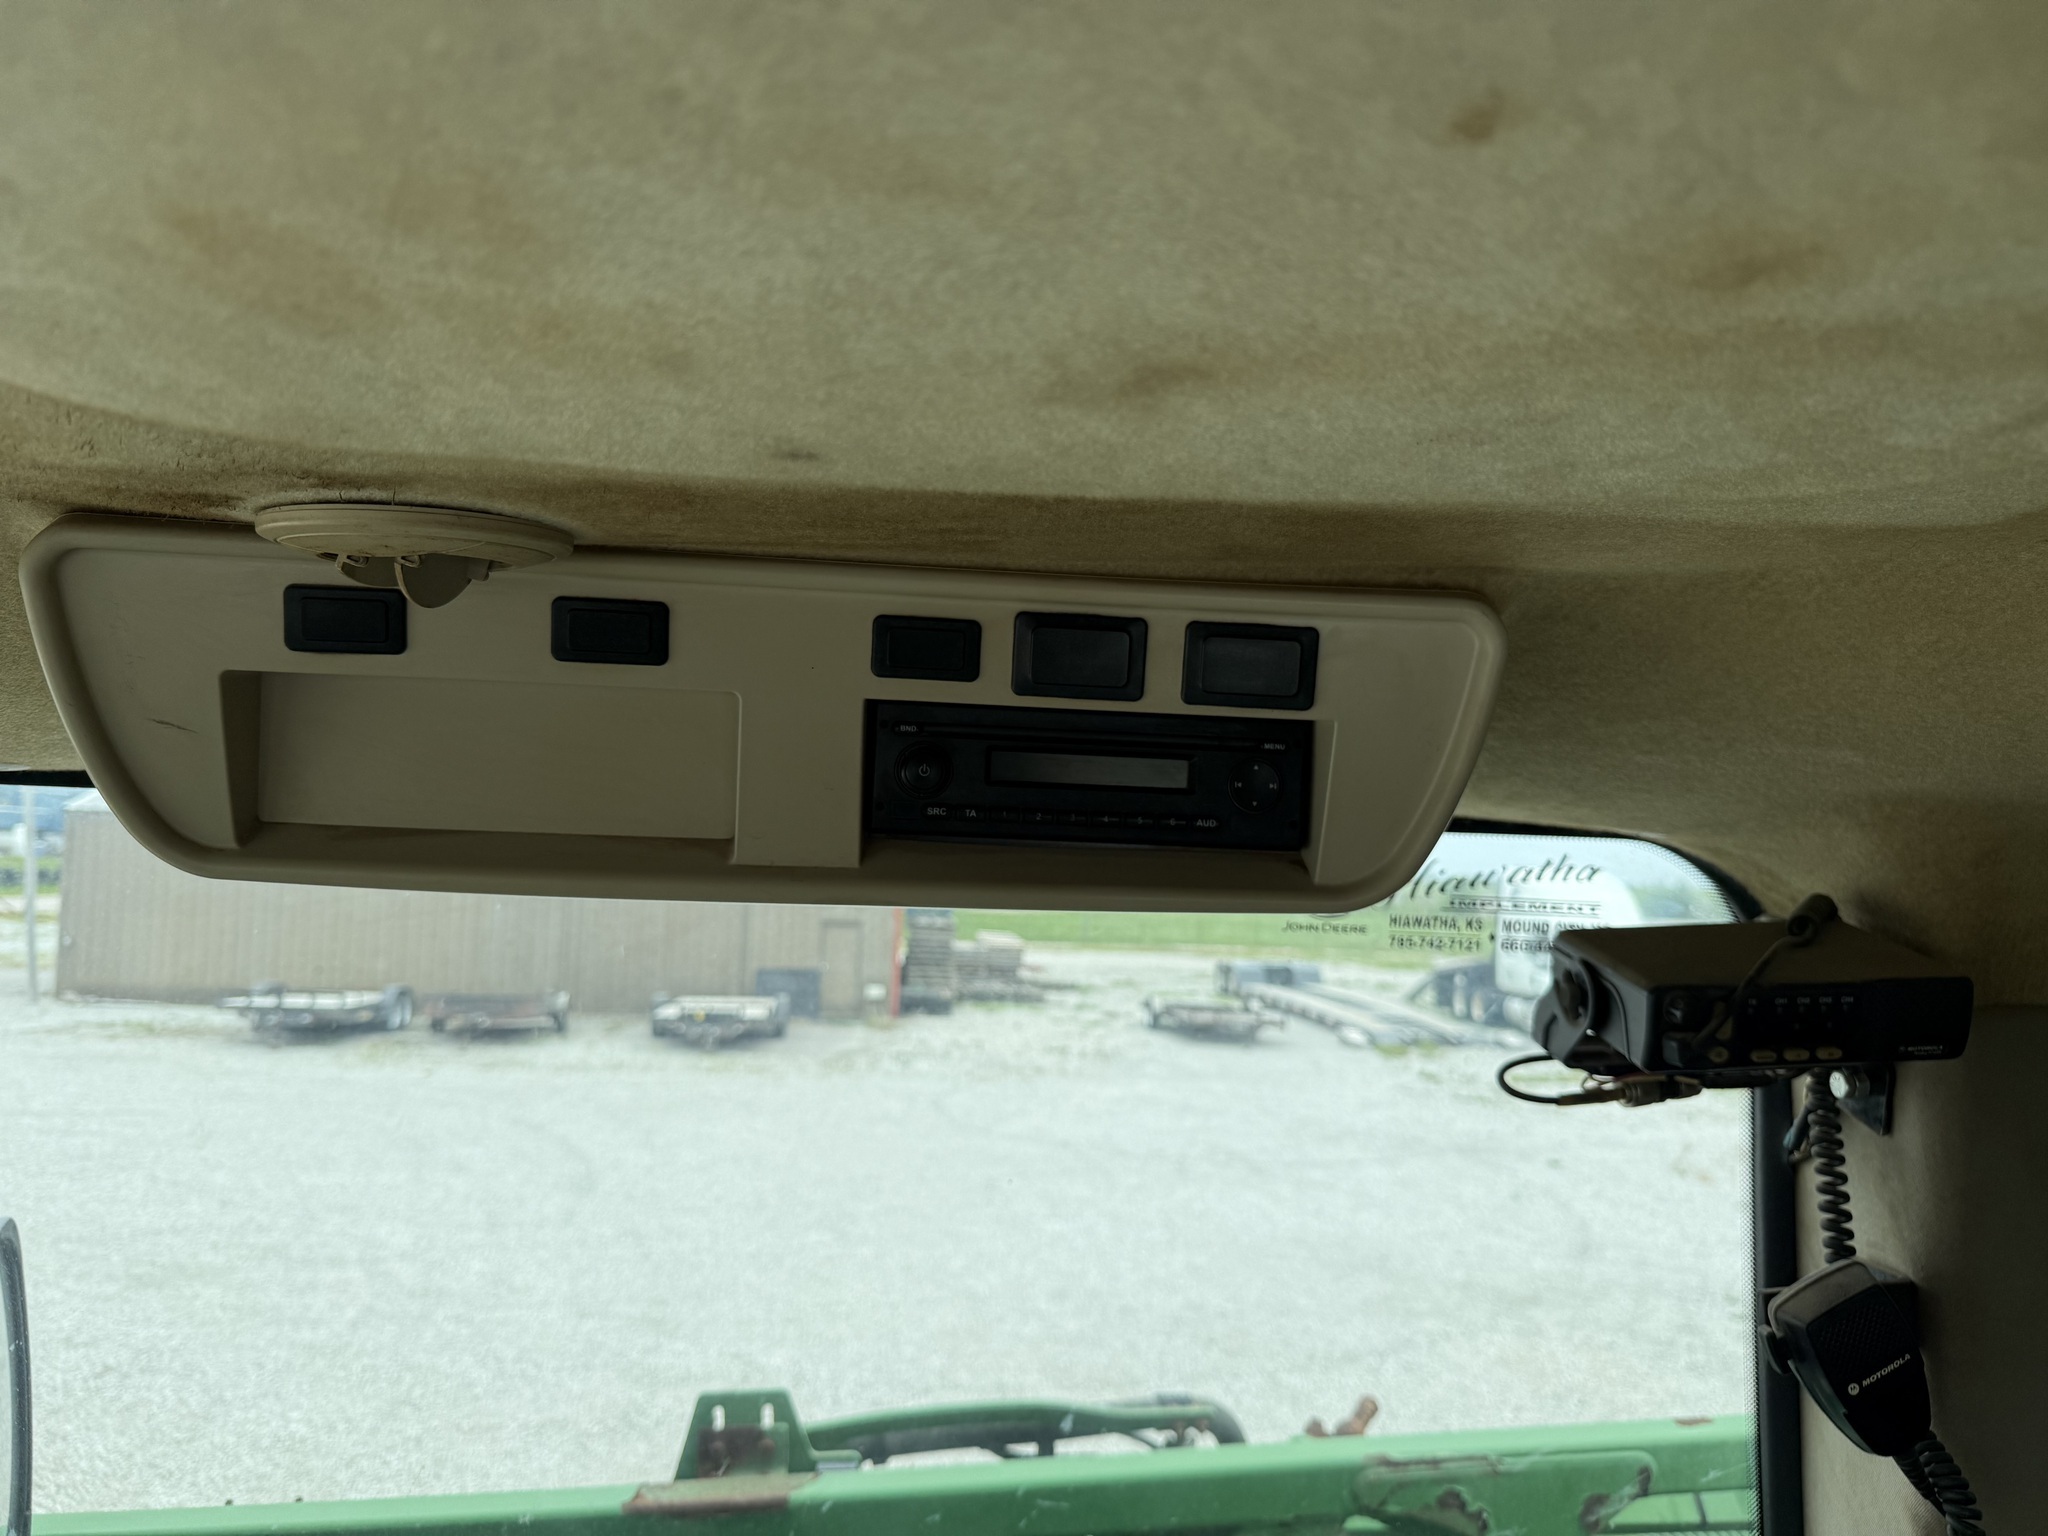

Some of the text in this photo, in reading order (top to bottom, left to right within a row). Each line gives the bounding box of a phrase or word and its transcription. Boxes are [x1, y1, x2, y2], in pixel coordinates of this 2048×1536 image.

[899, 724, 917, 733] BND
[1263, 742, 1286, 751] MENU
[926, 807, 947, 816] SRC
[965, 809, 977, 818] TA
[1035, 813, 1042, 821] 2
[1196, 818, 1217, 828] AUD
[1448, 898, 1602, 914] IMPLEMENT
[1281, 920, 1369, 935] JOHN DEERE
[1388, 913, 1484, 932] HIAWATHA, KS
[1501, 919, 1550, 935] MOUND
[1861, 1353, 1911, 1387] MOTOROLA
